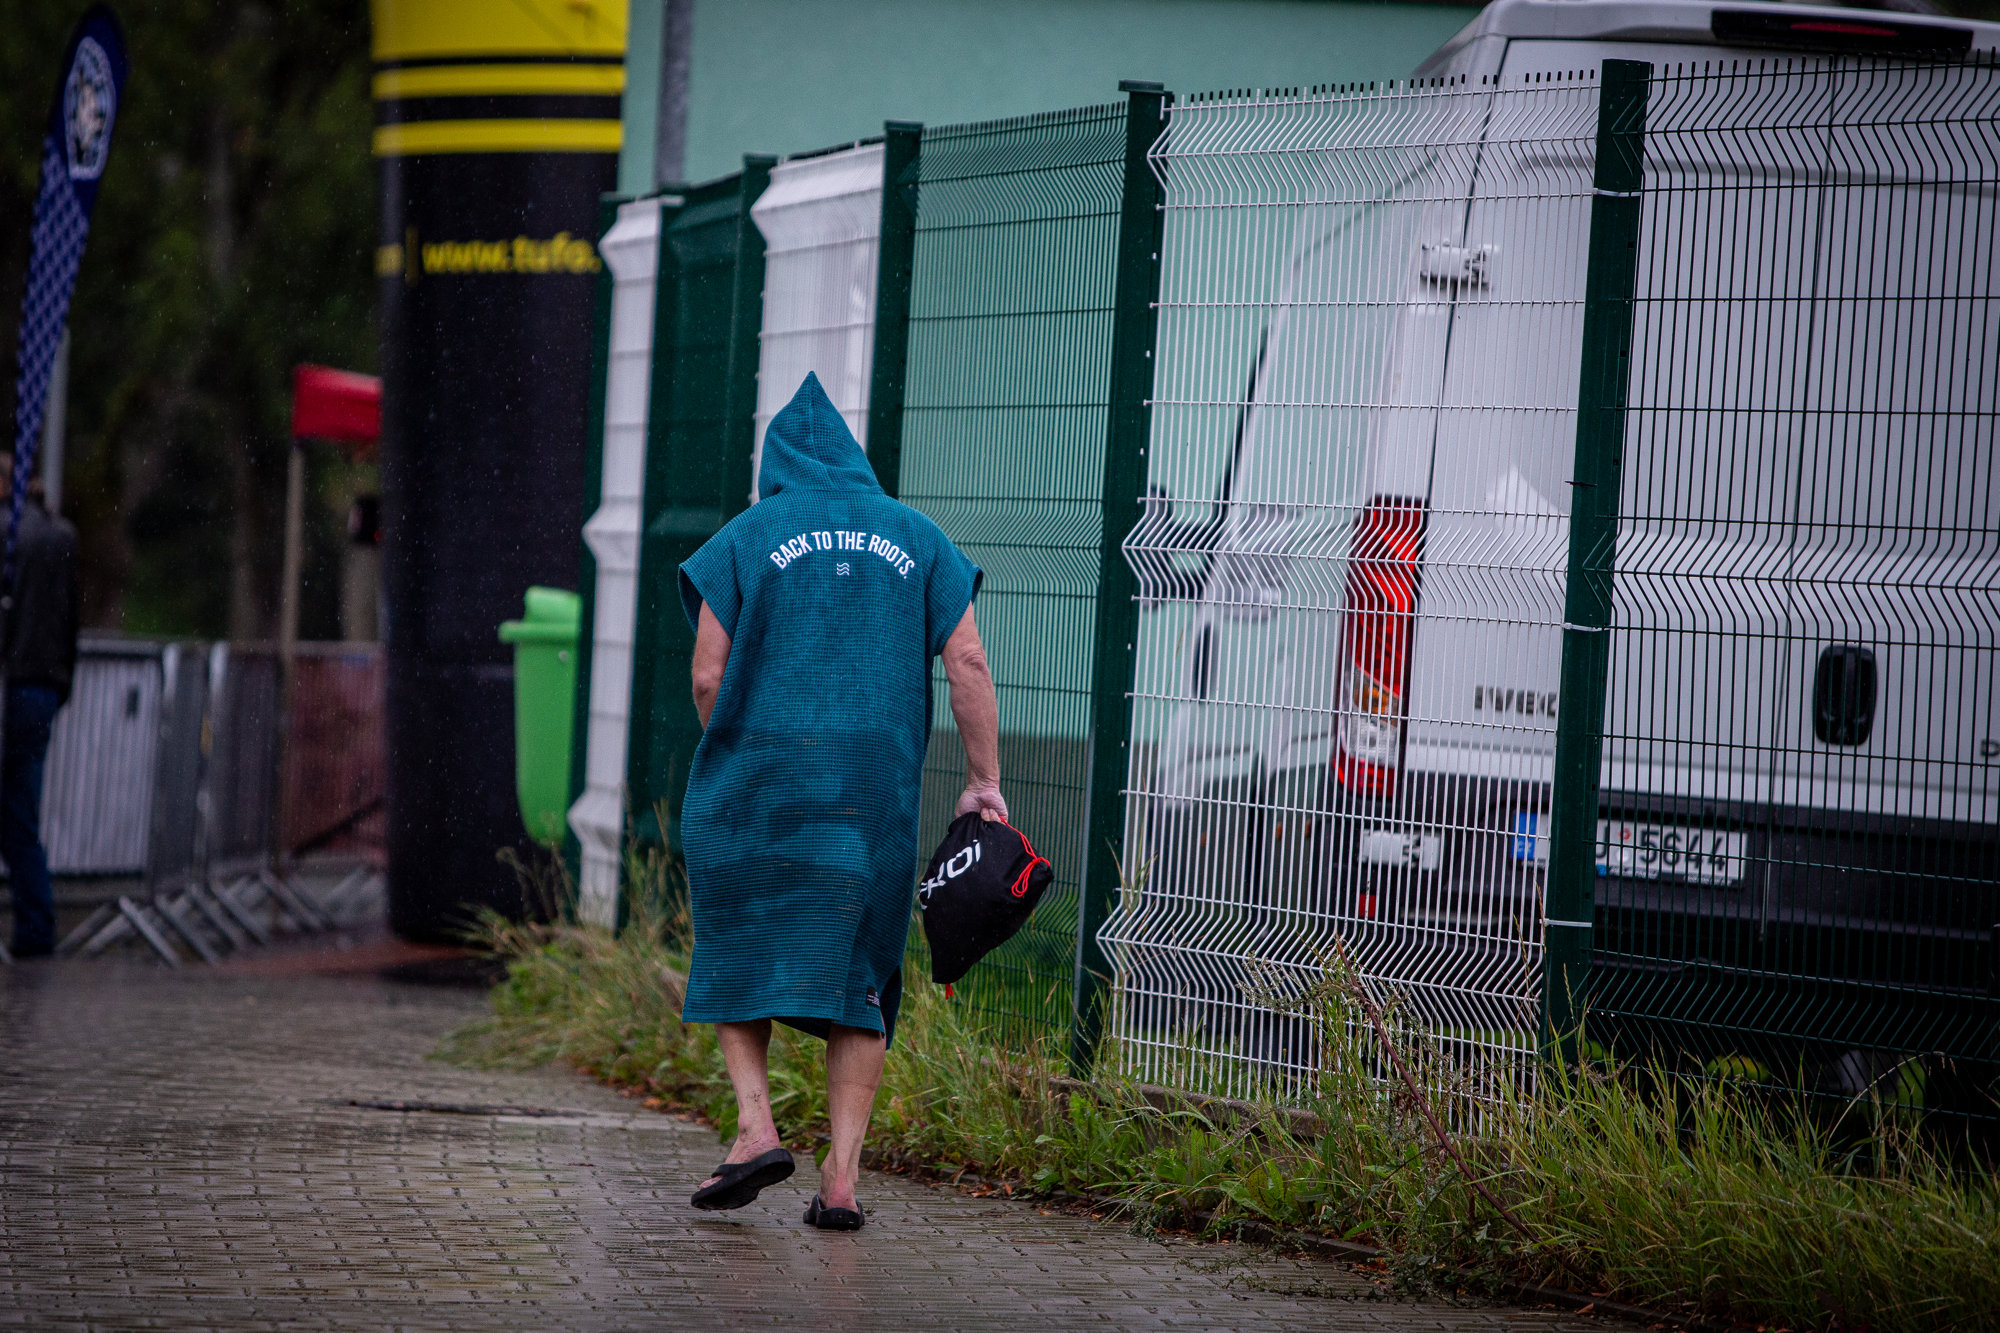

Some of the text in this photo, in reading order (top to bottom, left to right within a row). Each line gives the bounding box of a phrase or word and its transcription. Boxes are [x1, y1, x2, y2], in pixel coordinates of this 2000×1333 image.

[769, 530, 915, 580] BACK TO THE ROOTS.
[1639, 829, 1726, 871] 5644
